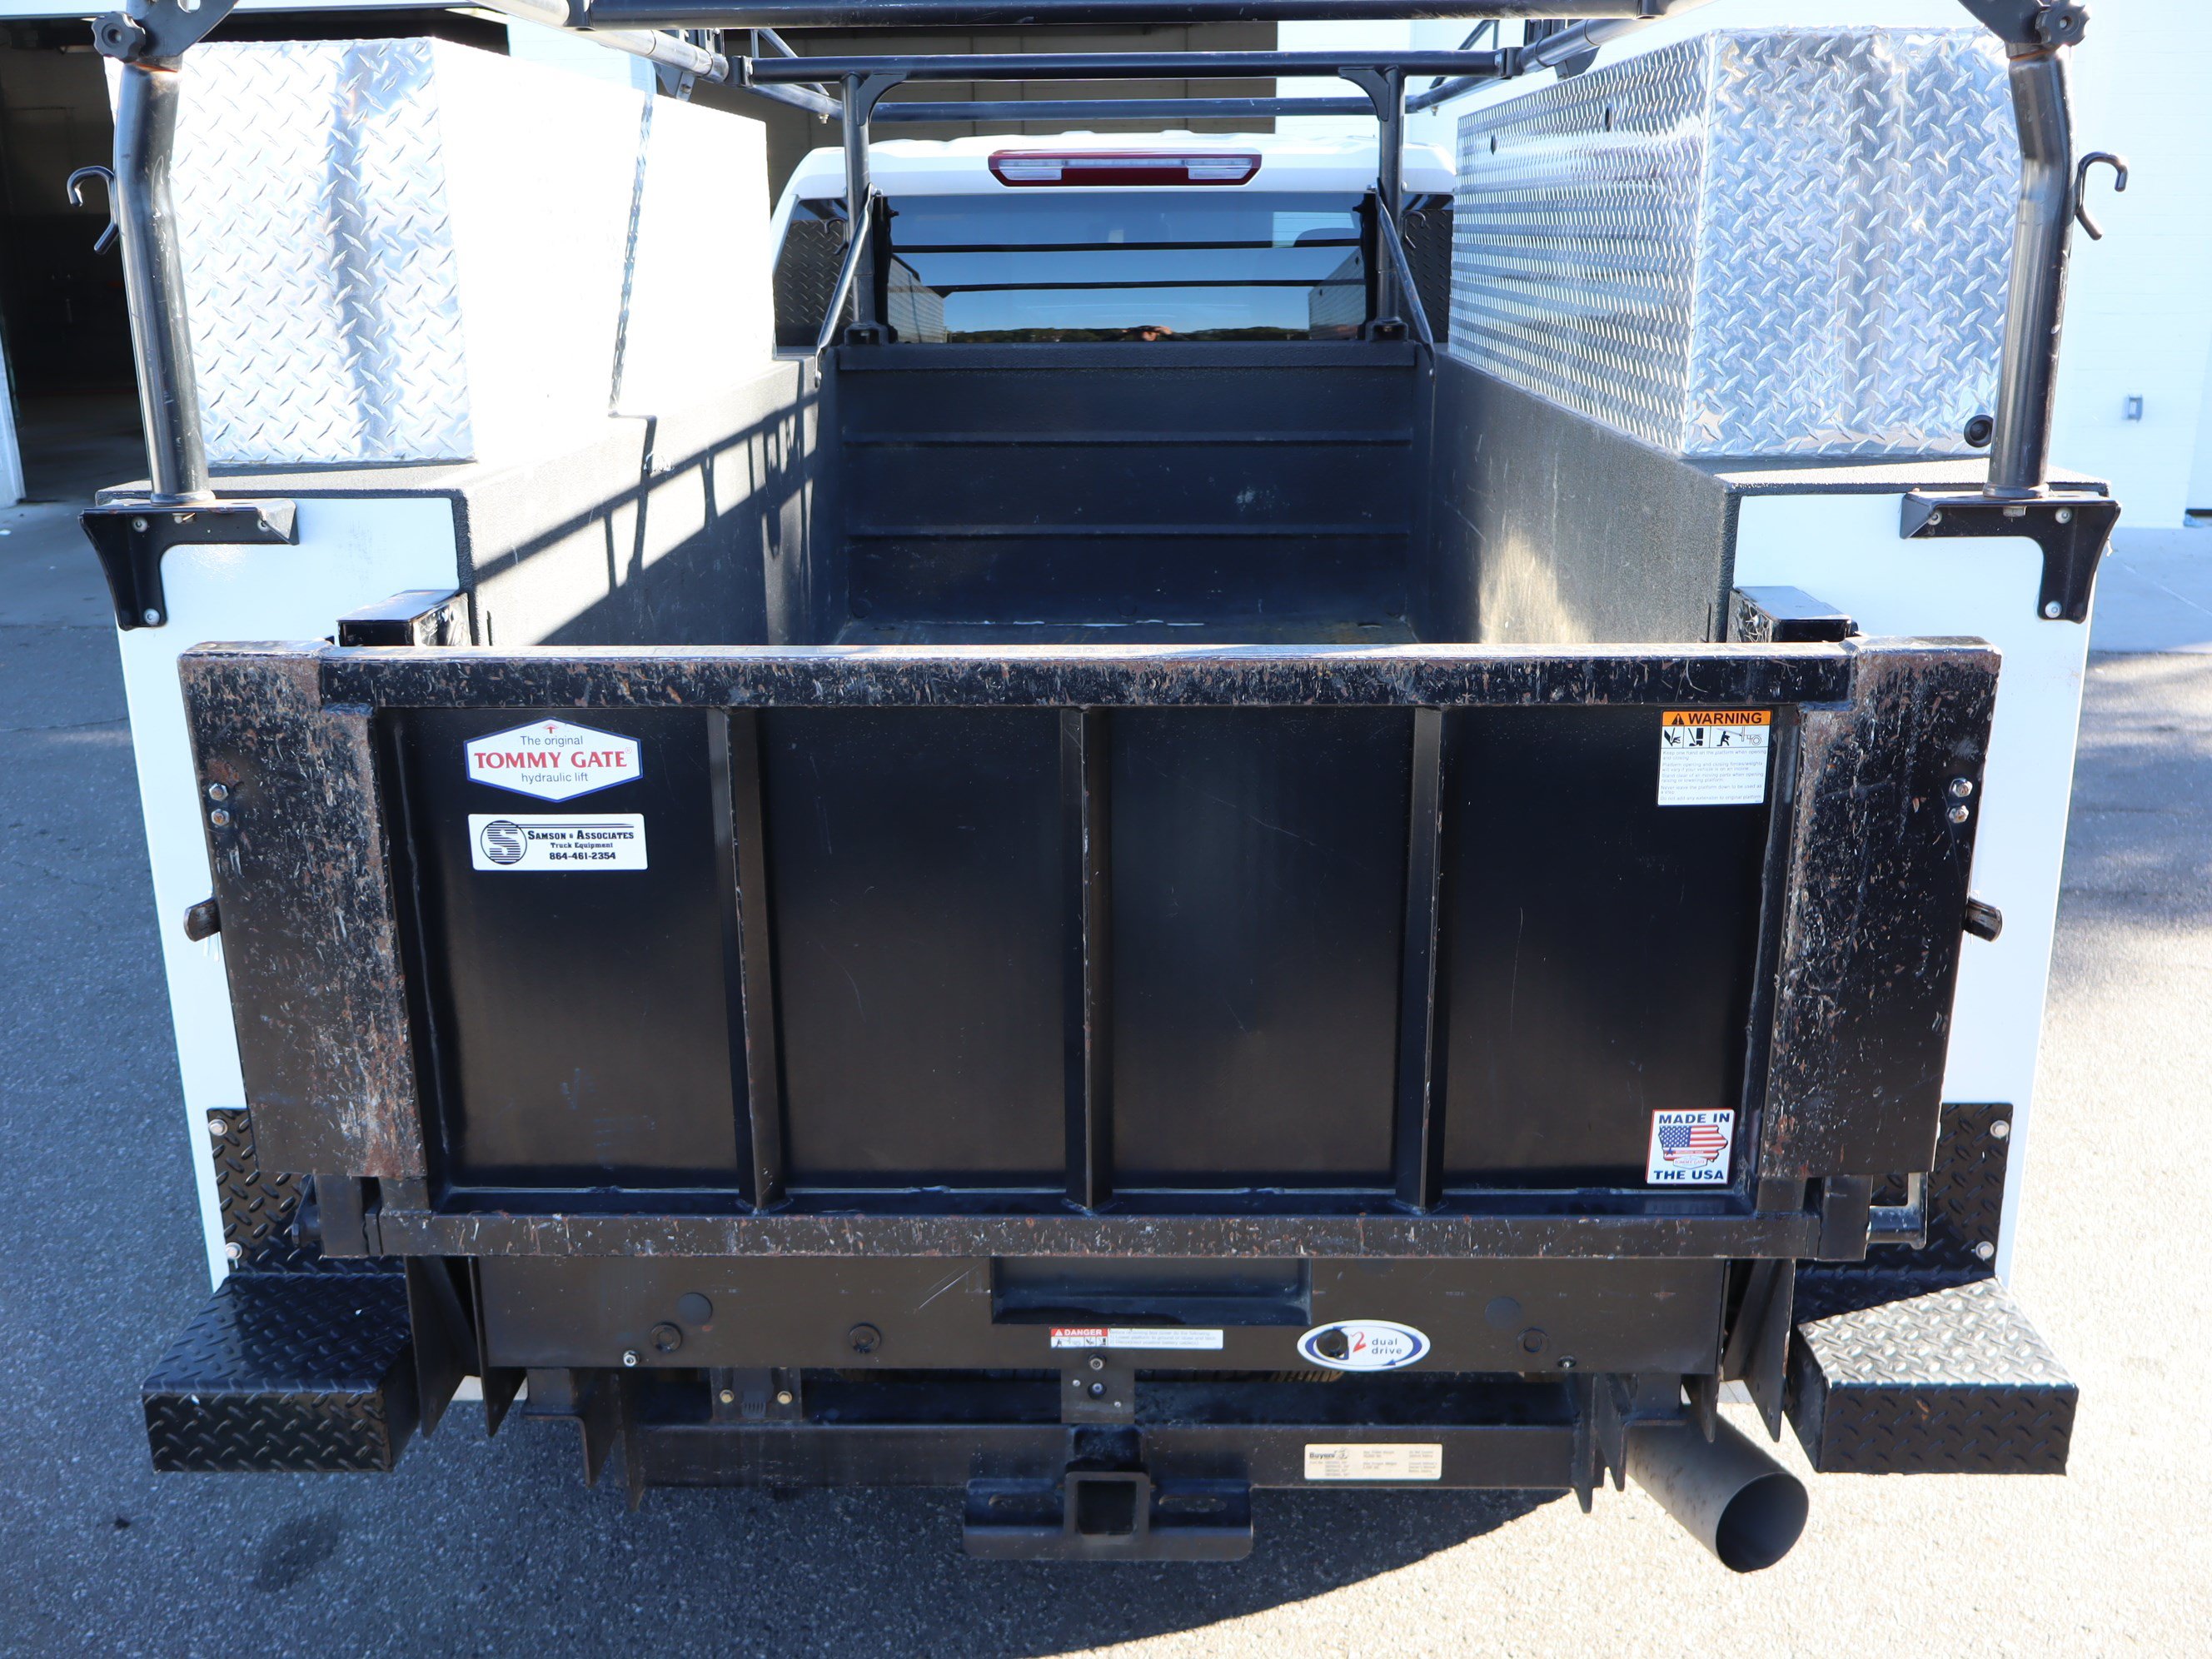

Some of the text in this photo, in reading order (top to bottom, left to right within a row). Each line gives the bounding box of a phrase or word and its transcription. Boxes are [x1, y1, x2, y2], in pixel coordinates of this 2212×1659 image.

[1688, 712, 1762, 724] WARNING
[520, 735, 583, 747] The original
[474, 752, 561, 769] TOMMY
[521, 772, 588, 785] hydraulic lift
[1659, 1113, 1730, 1123] MADE IN
[1654, 1170, 1724, 1180] THE USA
